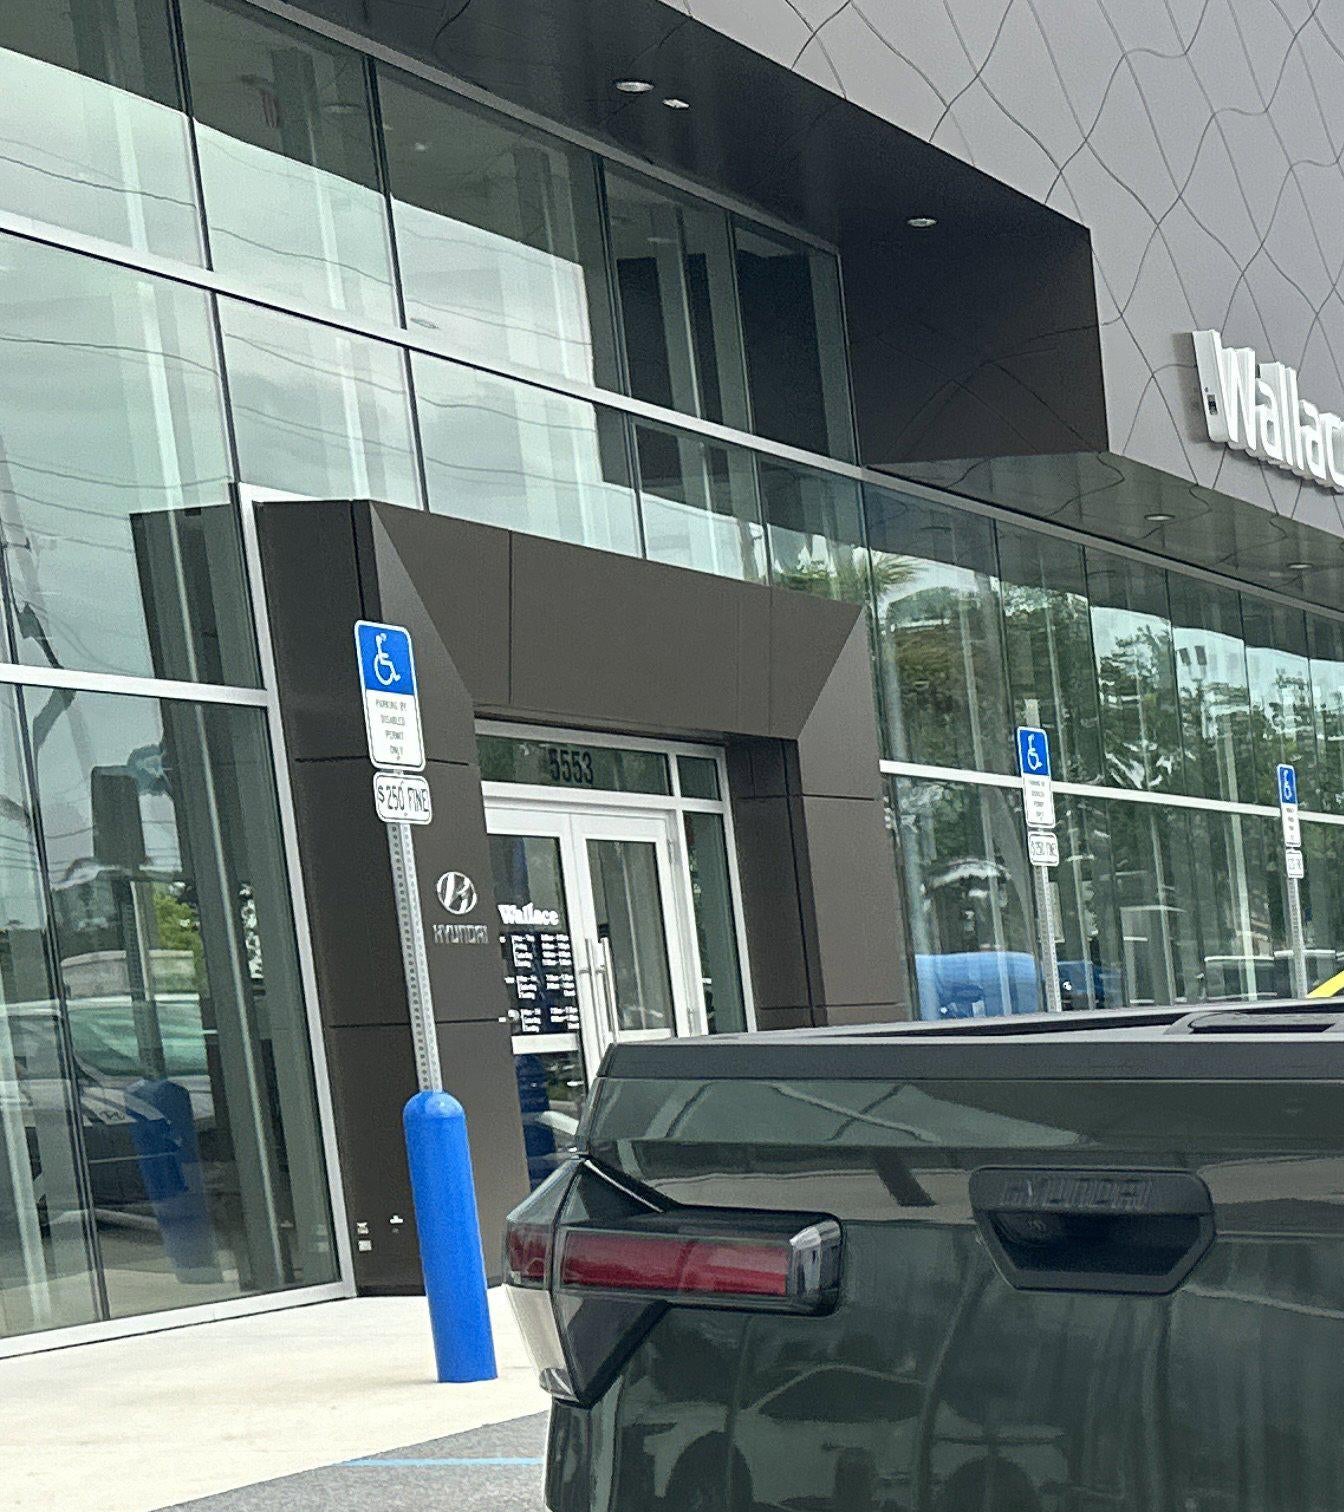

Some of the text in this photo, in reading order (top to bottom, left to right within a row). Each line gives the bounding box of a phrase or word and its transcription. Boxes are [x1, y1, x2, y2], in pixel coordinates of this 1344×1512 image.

[549, 748, 594, 785] 5553
[497, 902, 560, 926] Wallace
[432, 923, 489, 944] HYUNDAI
